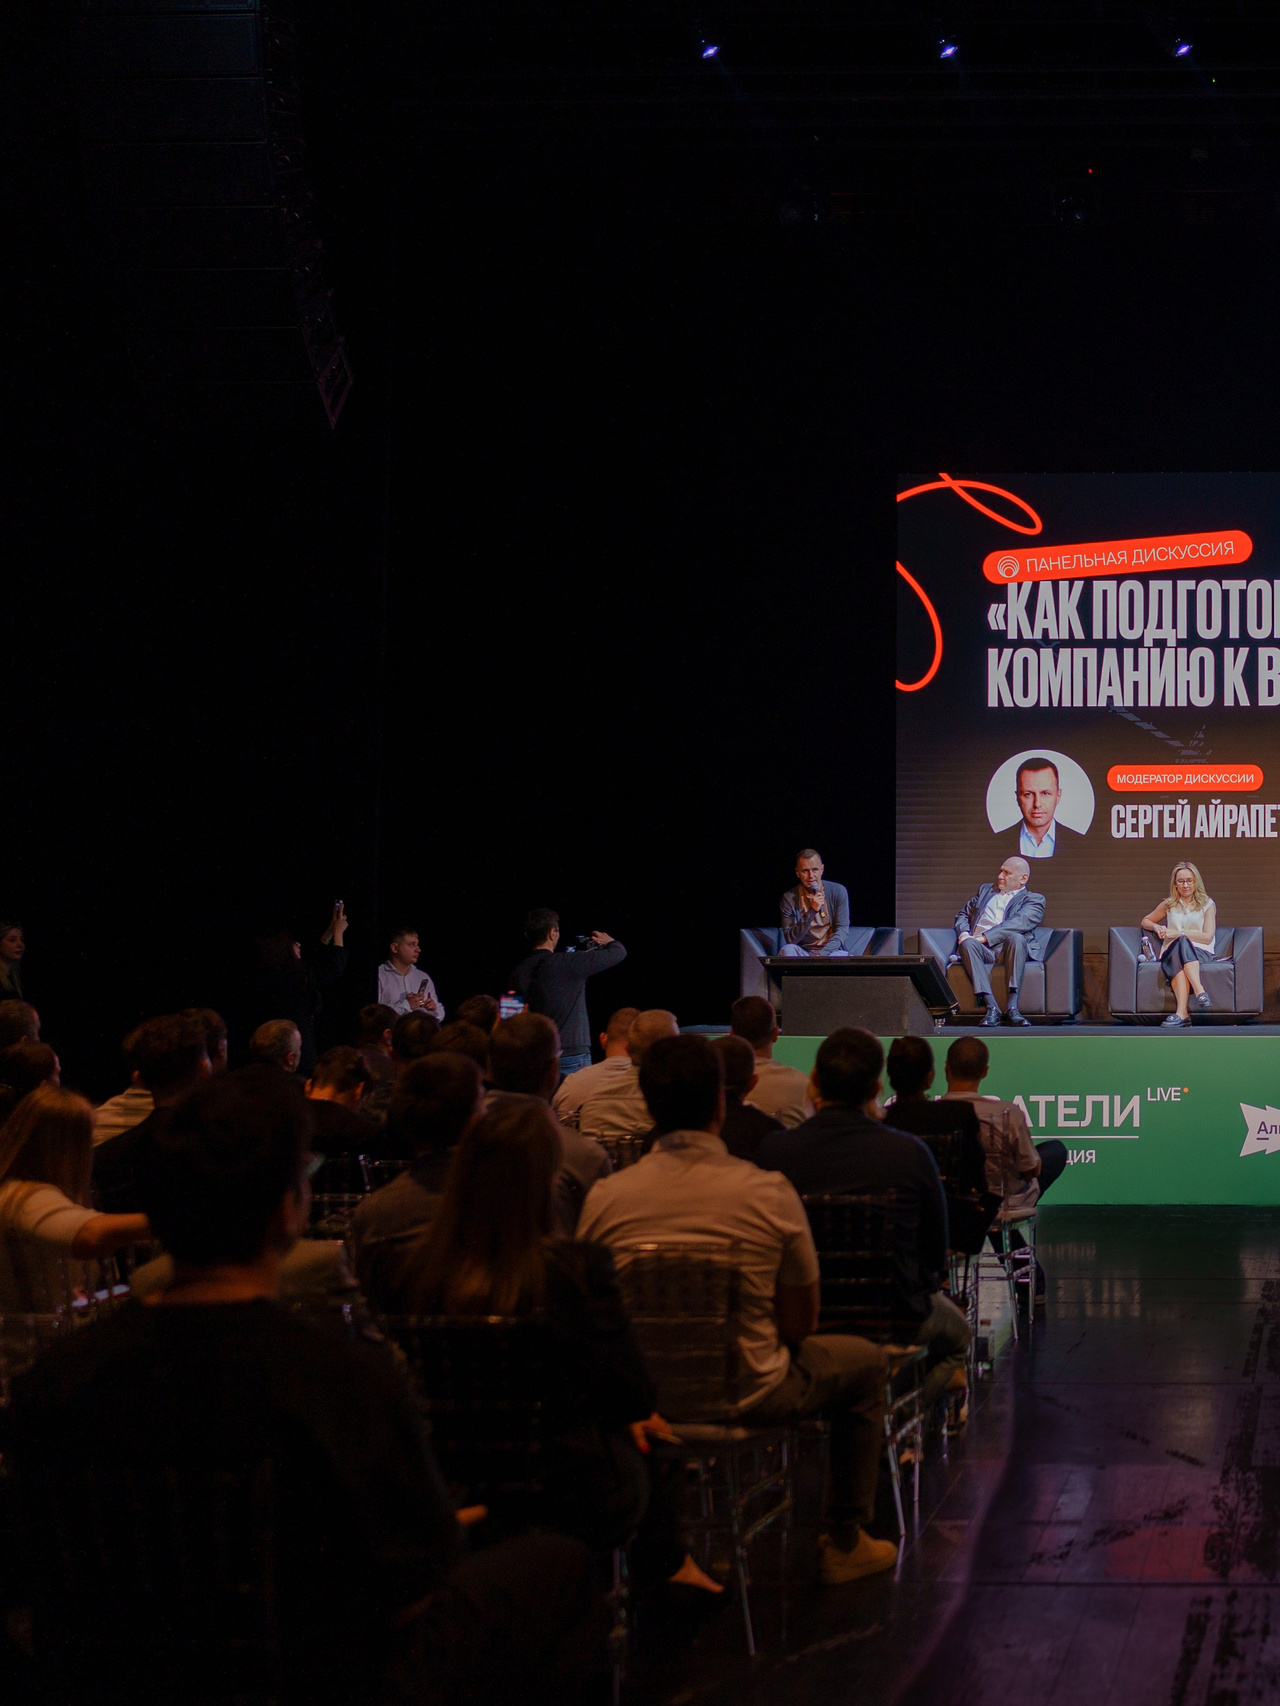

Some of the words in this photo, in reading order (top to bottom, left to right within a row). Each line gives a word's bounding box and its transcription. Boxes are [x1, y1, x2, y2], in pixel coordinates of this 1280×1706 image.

[1026, 550, 1128, 573] ПАНЕЛЬНАЯ
[1131, 540, 1235, 566] ДИСКУССИЯ
[987, 580, 1085, 640] «КАК
[987, 647, 1215, 707] КОМПАНИЮ
[1223, 647, 1250, 707] К
[1116, 773, 1183, 785] МОДЕРАТОР
[1184, 773, 1254, 785] ДИСКУССИИ
[1110, 799, 1191, 839] СЕРГЕЙ
[1147, 1087, 1181, 1101] LIVE
